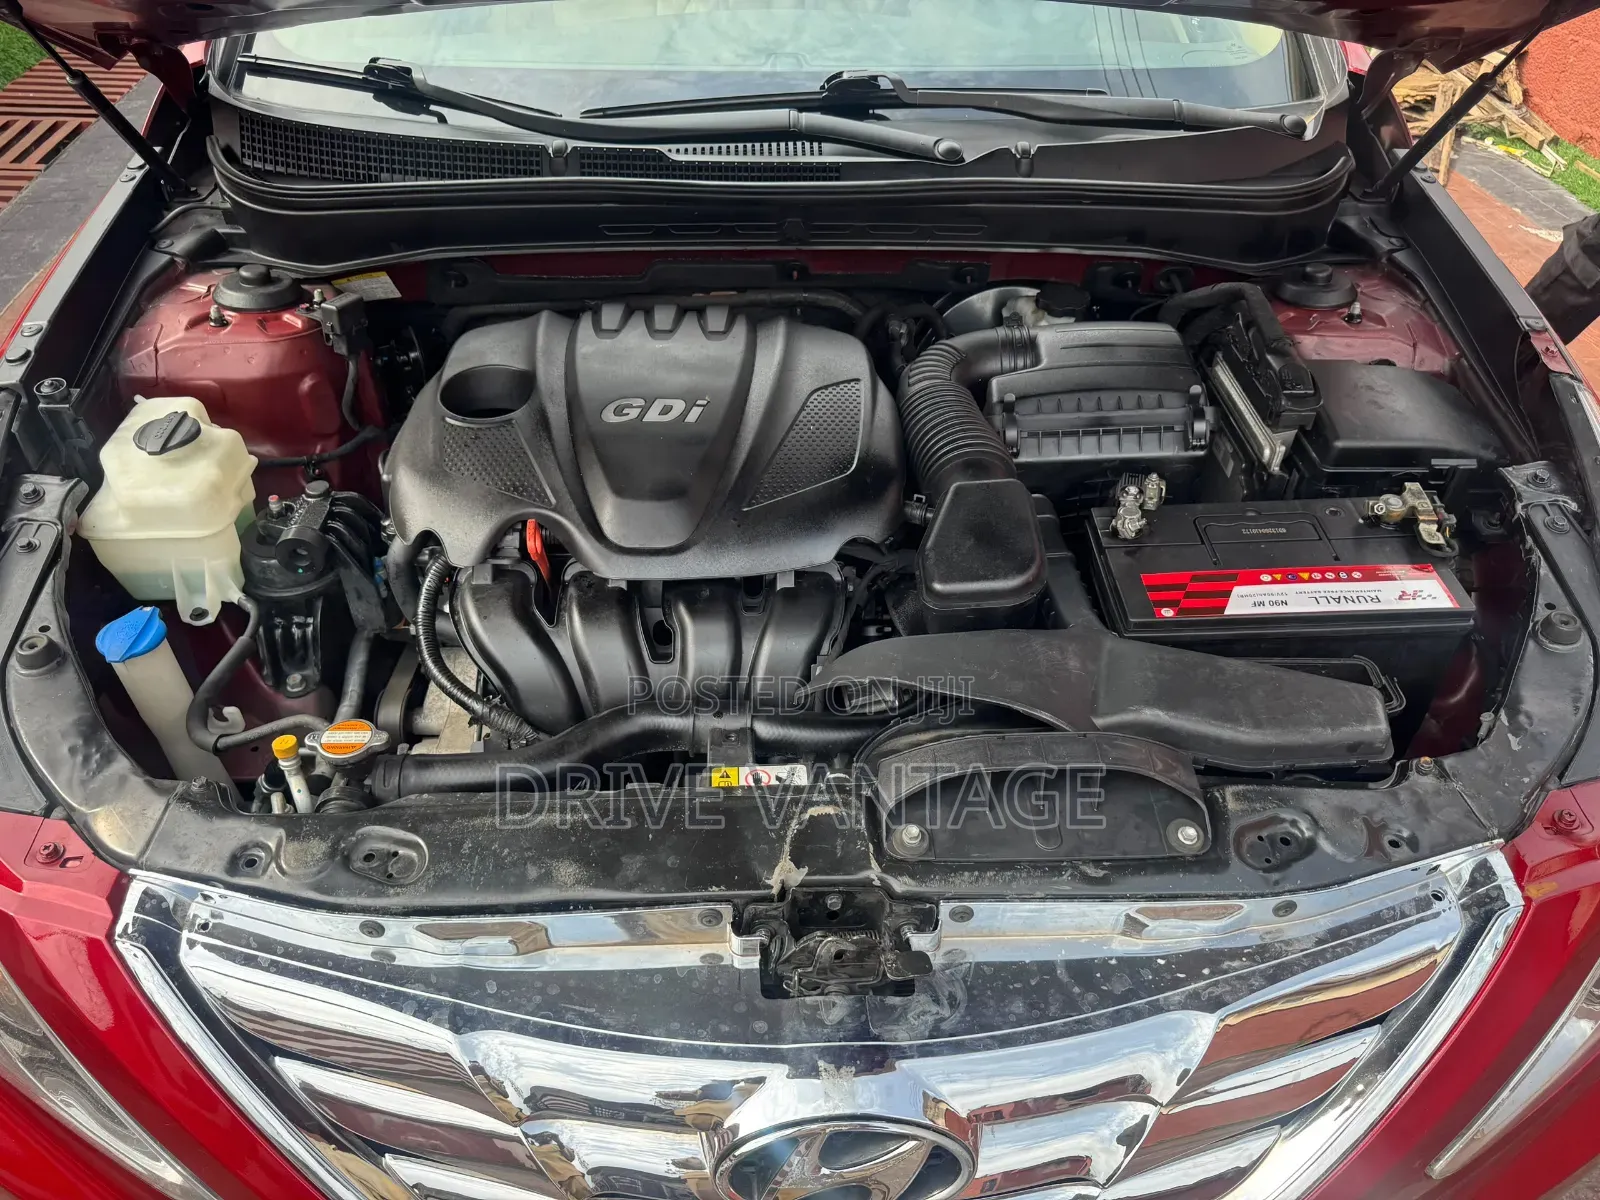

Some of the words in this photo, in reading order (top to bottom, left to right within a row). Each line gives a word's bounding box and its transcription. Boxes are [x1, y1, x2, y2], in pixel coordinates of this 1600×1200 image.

[600, 397, 710, 424] GDi
[1251, 600, 1265, 608] MF
[1268, 599, 1288, 607] N90
[1308, 595, 1382, 605] RUNALL
